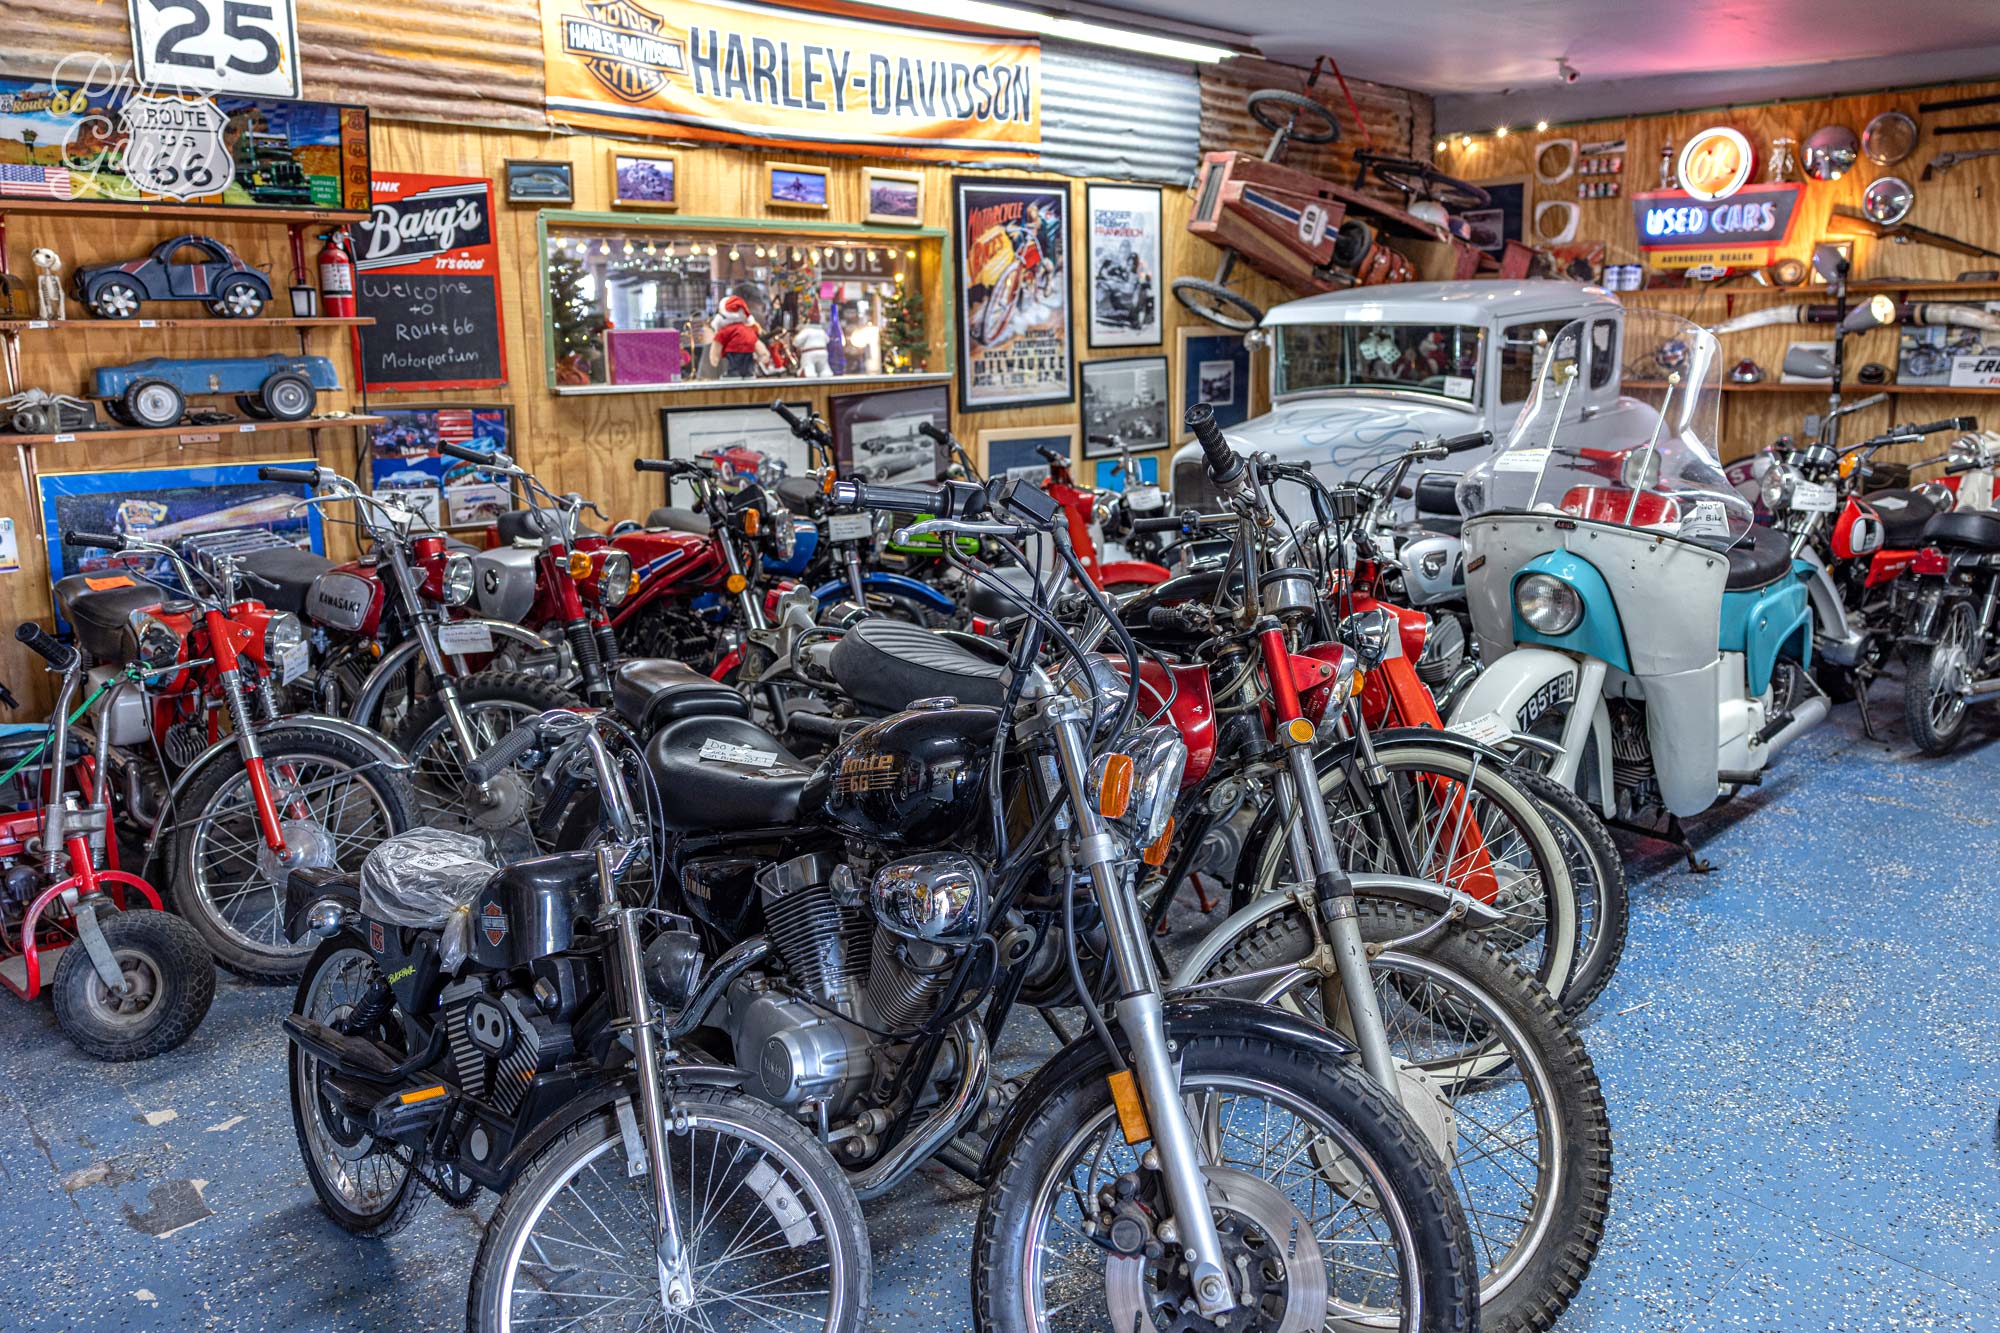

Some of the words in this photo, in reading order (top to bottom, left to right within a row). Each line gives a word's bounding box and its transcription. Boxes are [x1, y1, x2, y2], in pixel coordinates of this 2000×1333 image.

[592, 1, 653, 34] MOTOR
[155, 0, 281, 75] 25
[569, 22, 682, 68] HARLEY-DAVIDSON
[599, 60, 660, 94] CYCLES
[690, 26, 1032, 122] HARLEY-DAVIDSON
[51, 89, 88, 115] 66
[146, 108, 206, 127] ROUTE
[160, 134, 196, 147] US
[149, 152, 213, 186] 66
[1694, 142, 1735, 184] OK
[359, 198, 481, 259] Barg's
[967, 202, 1024, 255] MOTORCYCLE
[1646, 207, 1708, 236] USED
[1711, 202, 1777, 233] CARS
[1662, 255, 1714, 263] AUTHORIZED
[1720, 253, 1754, 261] DEALER
[363, 281, 472, 301] Welcome
[409, 303, 434, 315] to
[396, 319, 451, 342] Route
[453, 317, 475, 336] 66
[382, 347, 479, 370] Motorporium
[974, 356, 1065, 374] MILWAUKEE
[319, 591, 361, 613] KAWASAKI
[1519, 690, 1549, 732] 785
[1549, 673, 1574, 704] FBP
[841, 754, 894, 774] Route
